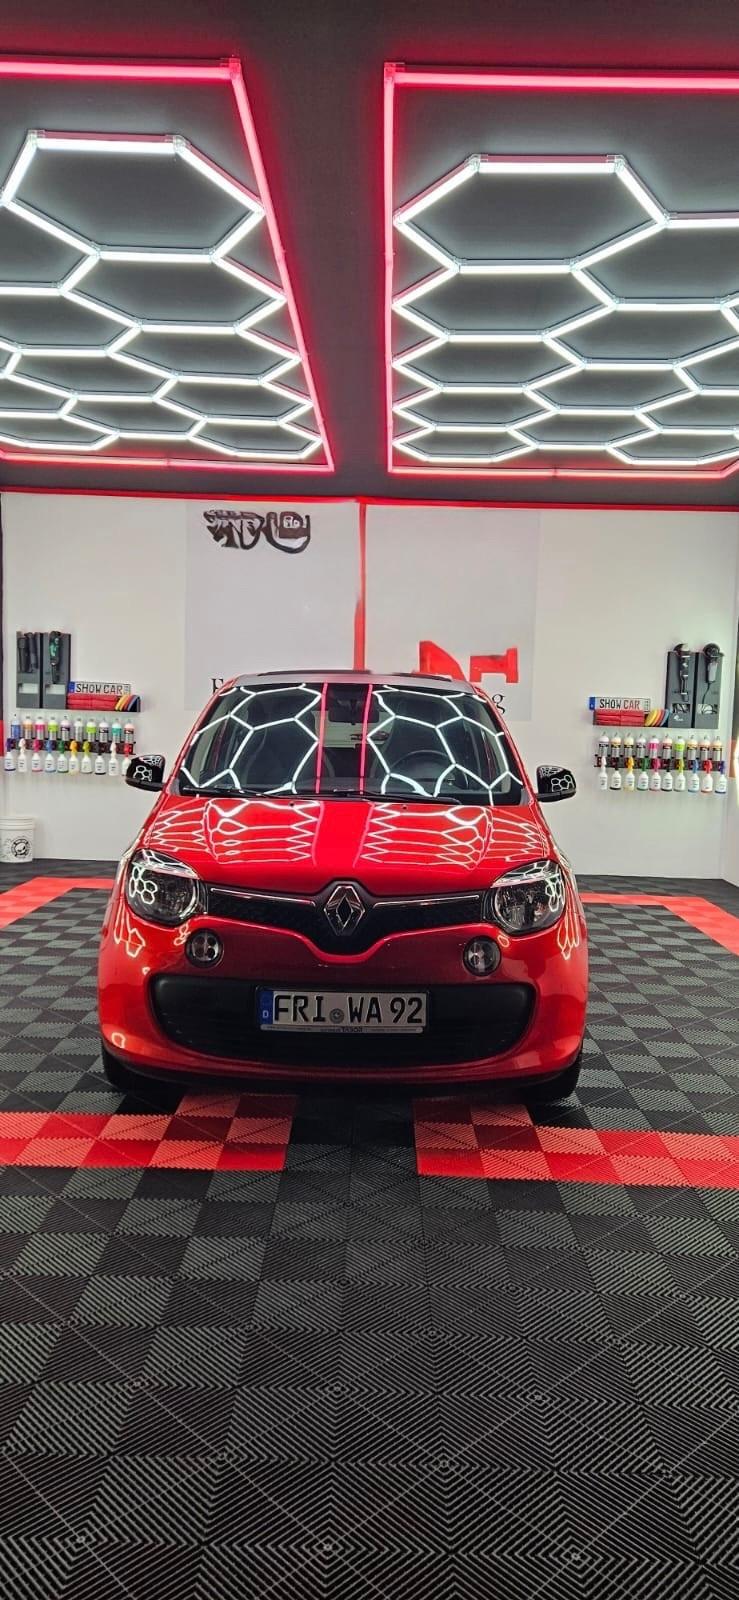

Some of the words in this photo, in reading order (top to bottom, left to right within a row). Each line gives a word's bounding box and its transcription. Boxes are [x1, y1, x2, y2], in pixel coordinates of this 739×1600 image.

[76, 683, 101, 693] SHOW
[103, 684, 123, 694] CAR
[599, 698, 621, 709] SHOW
[623, 699, 640, 710] CAR
[274, 995, 326, 1022] FRI
[348, 997, 382, 1023] WA
[390, 997, 422, 1024] 92
